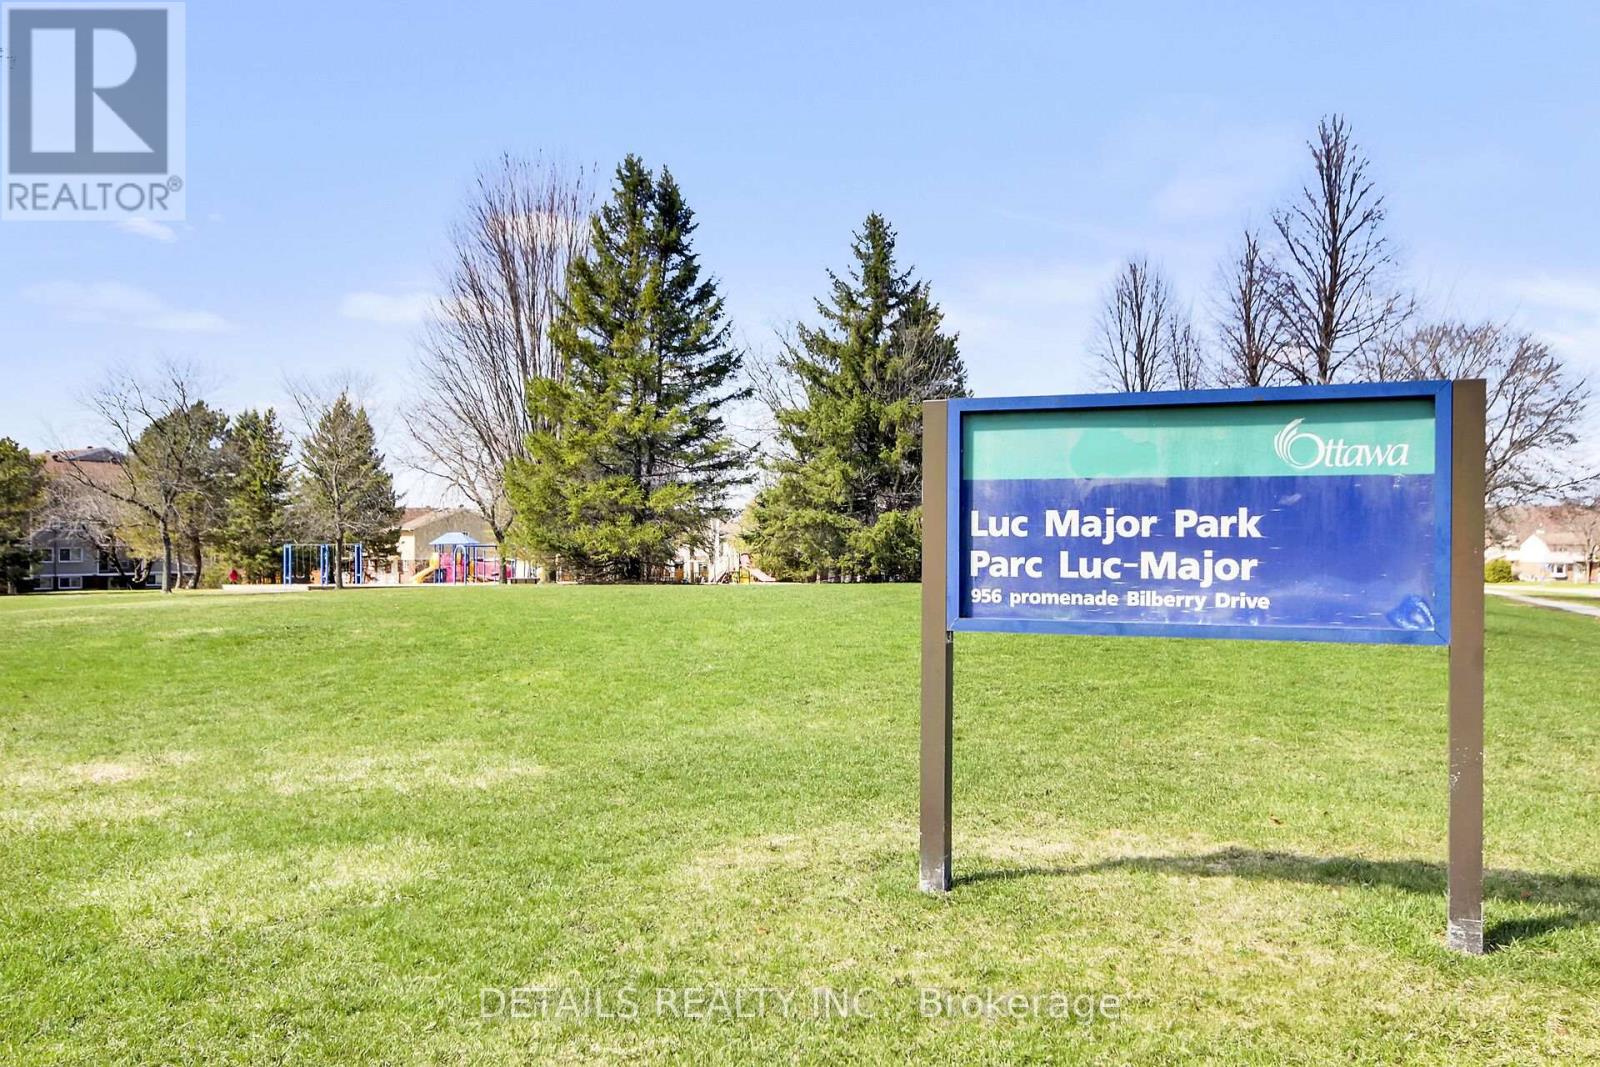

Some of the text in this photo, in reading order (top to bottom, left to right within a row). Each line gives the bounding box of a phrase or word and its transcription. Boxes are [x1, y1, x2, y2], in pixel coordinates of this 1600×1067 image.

[1274, 417, 1409, 470] Ottawa
[970, 508, 1264, 545] Luc Major Park
[970, 550, 1258, 588] Parc Luc-Major
[971, 588, 1270, 611] 956 promenade Bilberry Drive
